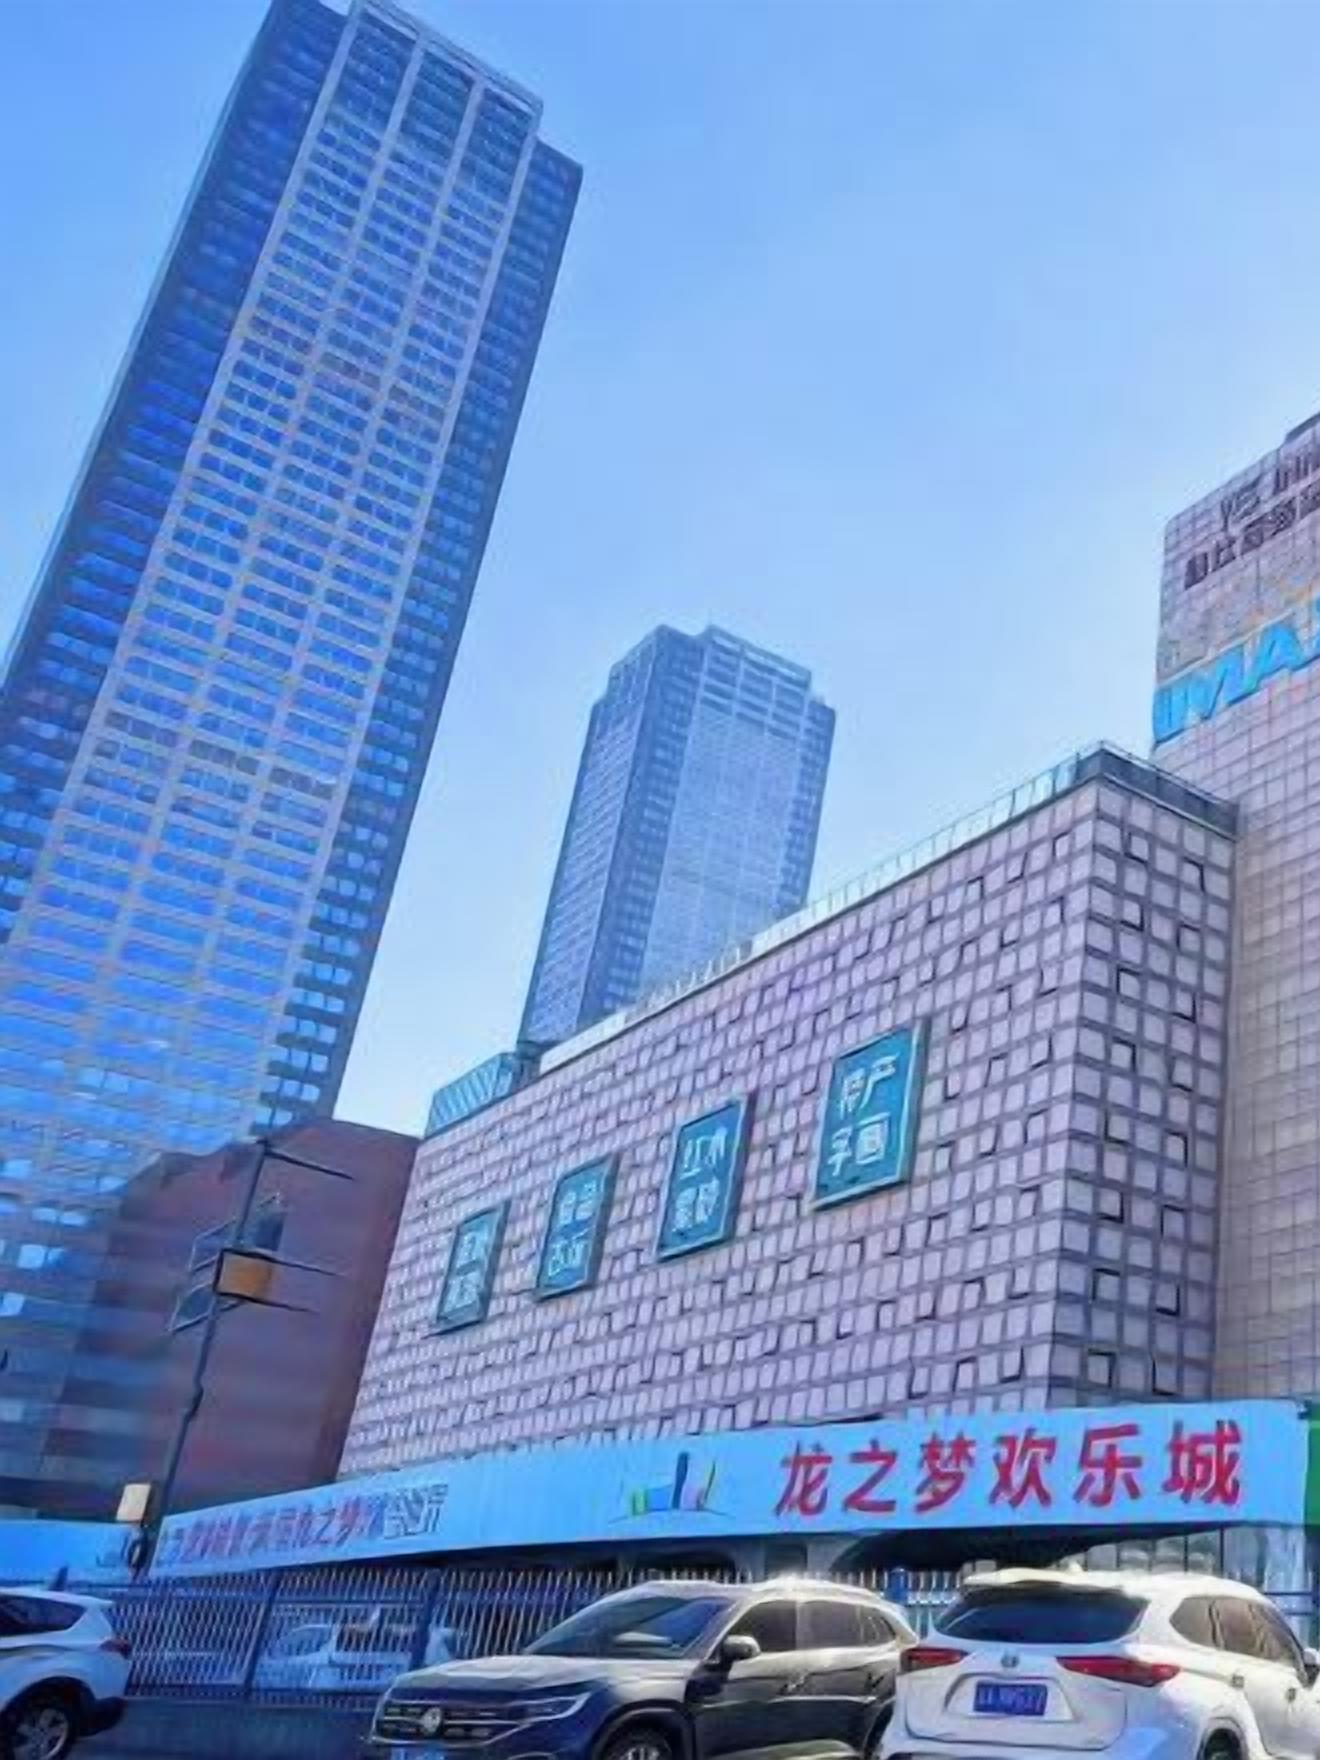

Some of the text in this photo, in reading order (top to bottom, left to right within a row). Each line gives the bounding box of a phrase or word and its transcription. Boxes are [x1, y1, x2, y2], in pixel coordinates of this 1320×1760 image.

[774, 1419, 1243, 1518] 龙之梦欢乐城
